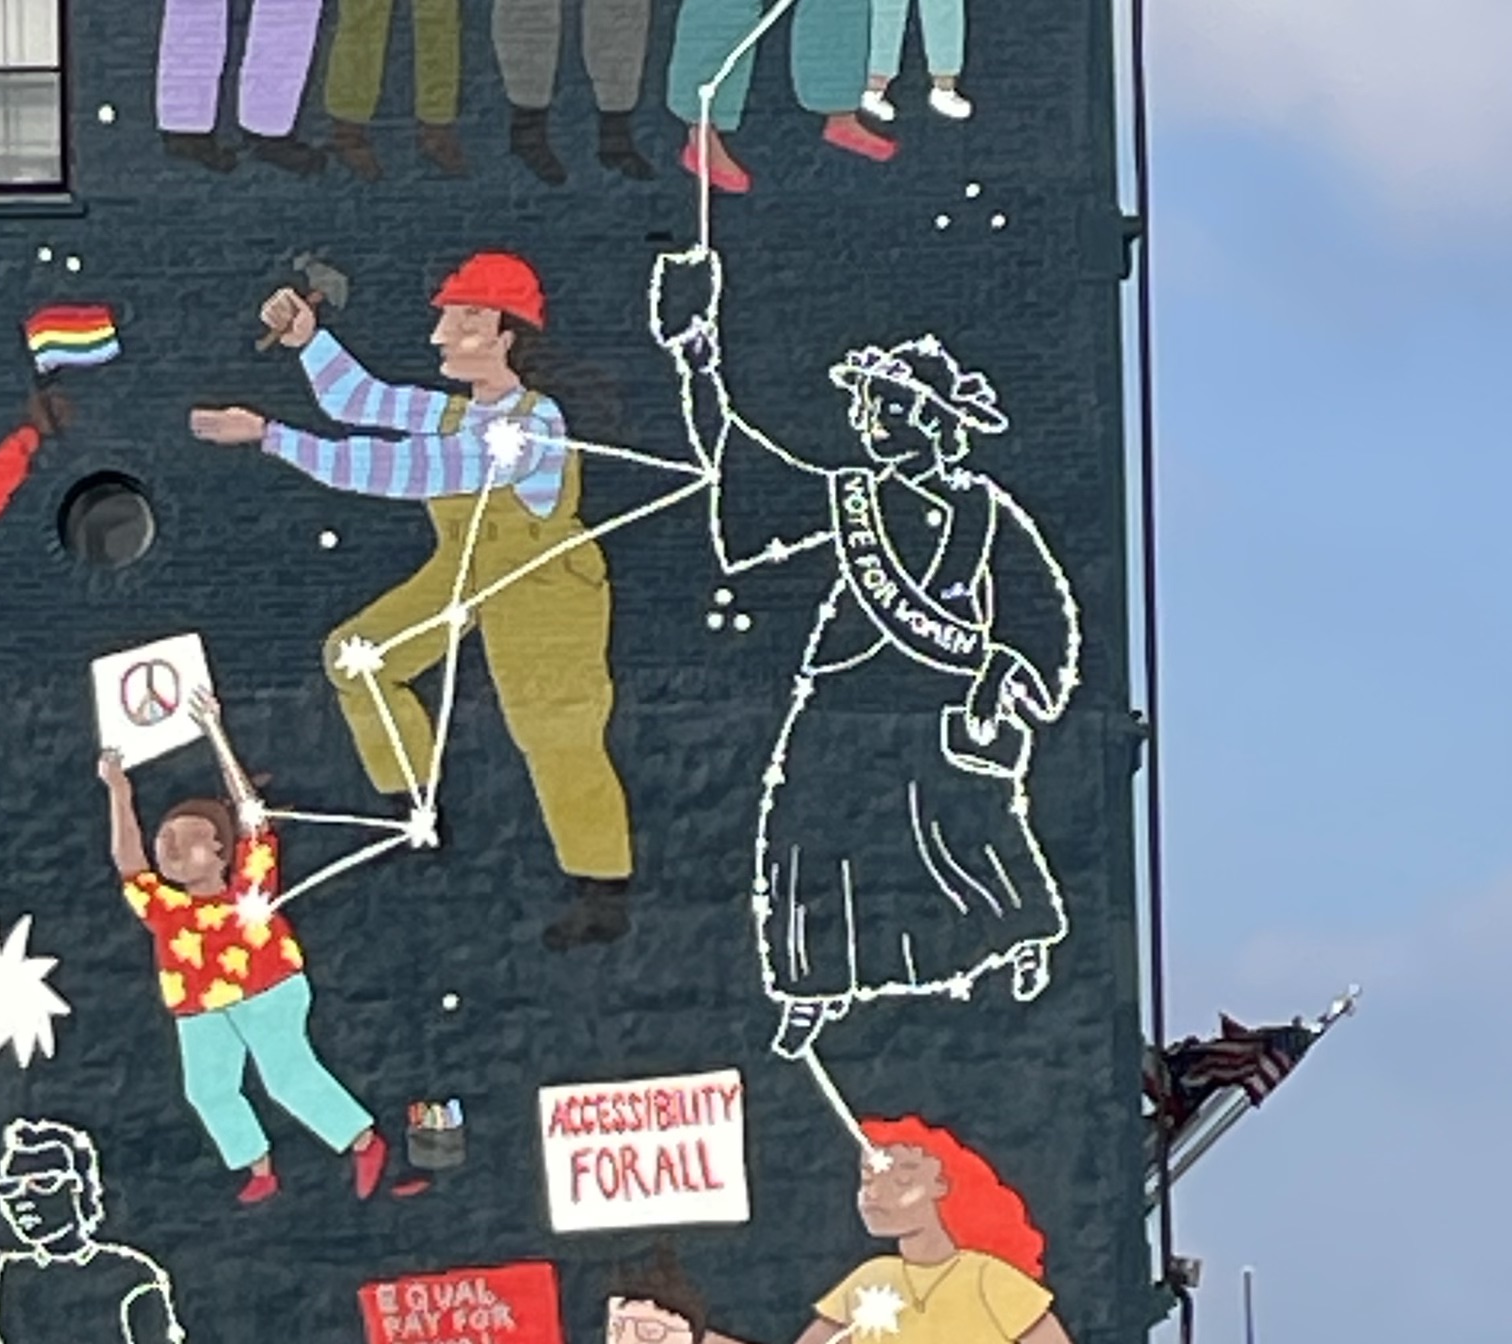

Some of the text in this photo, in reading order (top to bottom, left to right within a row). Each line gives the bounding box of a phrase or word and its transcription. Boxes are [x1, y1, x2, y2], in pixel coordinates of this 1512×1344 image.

[844, 477, 876, 548] VOTE
[854, 554, 899, 608] FOR
[548, 1083, 744, 1138] ACCESSIBILITY
[571, 1137, 725, 1204] FOR ALL
[376, 1277, 498, 1313] EQUAL
[382, 1303, 517, 1342] PAY FOR
